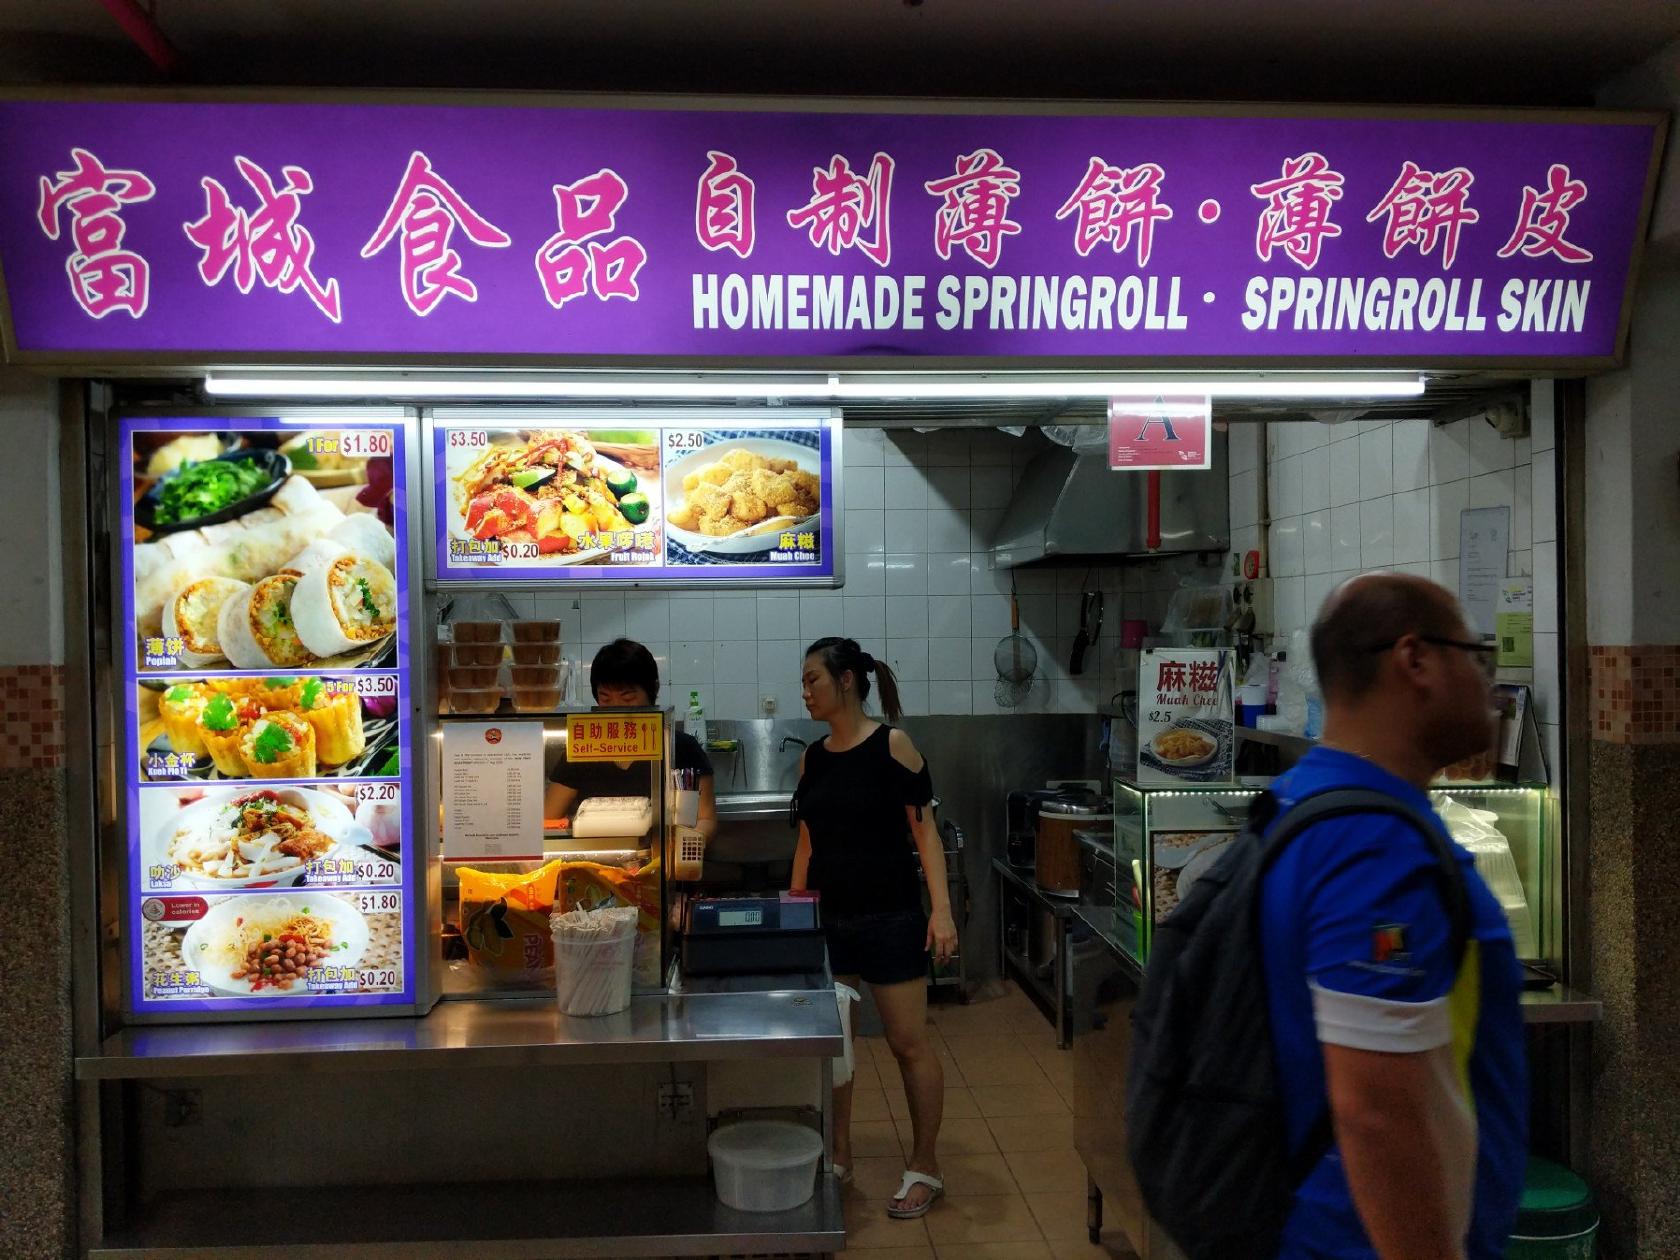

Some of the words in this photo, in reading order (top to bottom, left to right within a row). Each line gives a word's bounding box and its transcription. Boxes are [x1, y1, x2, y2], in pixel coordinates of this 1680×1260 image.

[37, 148, 648, 324] 富城食品
[692, 273, 926, 331] HOMEMADE
[935, 274, 1188, 331] SPRINGROLL
[1241, 276, 1487, 332] SPRINGROLL
[1496, 278, 1591, 333] SKIN
[307, 437, 314, 453] 1
[316, 437, 339, 453] For
[344, 434, 388, 455] $1.80
[451, 431, 486, 447] $3.50
[668, 433, 703, 448] $2.50
[451, 539, 500, 554] 打包加
[503, 544, 539, 560] $0.20
[451, 554, 486, 562] Takeaway
[611, 552, 630, 561] Fruit
[631, 552, 655, 561] Rojak
[770, 551, 793, 561] Muah
[794, 551, 815, 561] Chee
[146, 656, 177, 666] Popiah
[1157, 660, 1218, 692] 麻糍
[327, 681, 335, 692] 5
[336, 681, 355, 692] For
[357, 677, 394, 694] $3.50
[1156, 693, 1189, 705] Muah
[1193, 693, 1218, 706] Chee
[572, 722, 638, 740] 自助服務
[573, 743, 638, 753] Self-Service
[148, 752, 196, 768] 小金杯
[360, 785, 395, 802] $2.20
[305, 859, 354, 874] 打包加
[358, 864, 394, 880] $0.20
[151, 880, 171, 888] Laksa
[305, 874, 340, 883] Takeaway
[361, 894, 397, 912] $1.80
[306, 966, 355, 981] 打包加
[360, 971, 395, 986] $0.20
[307, 981, 343, 990] Takeaway
